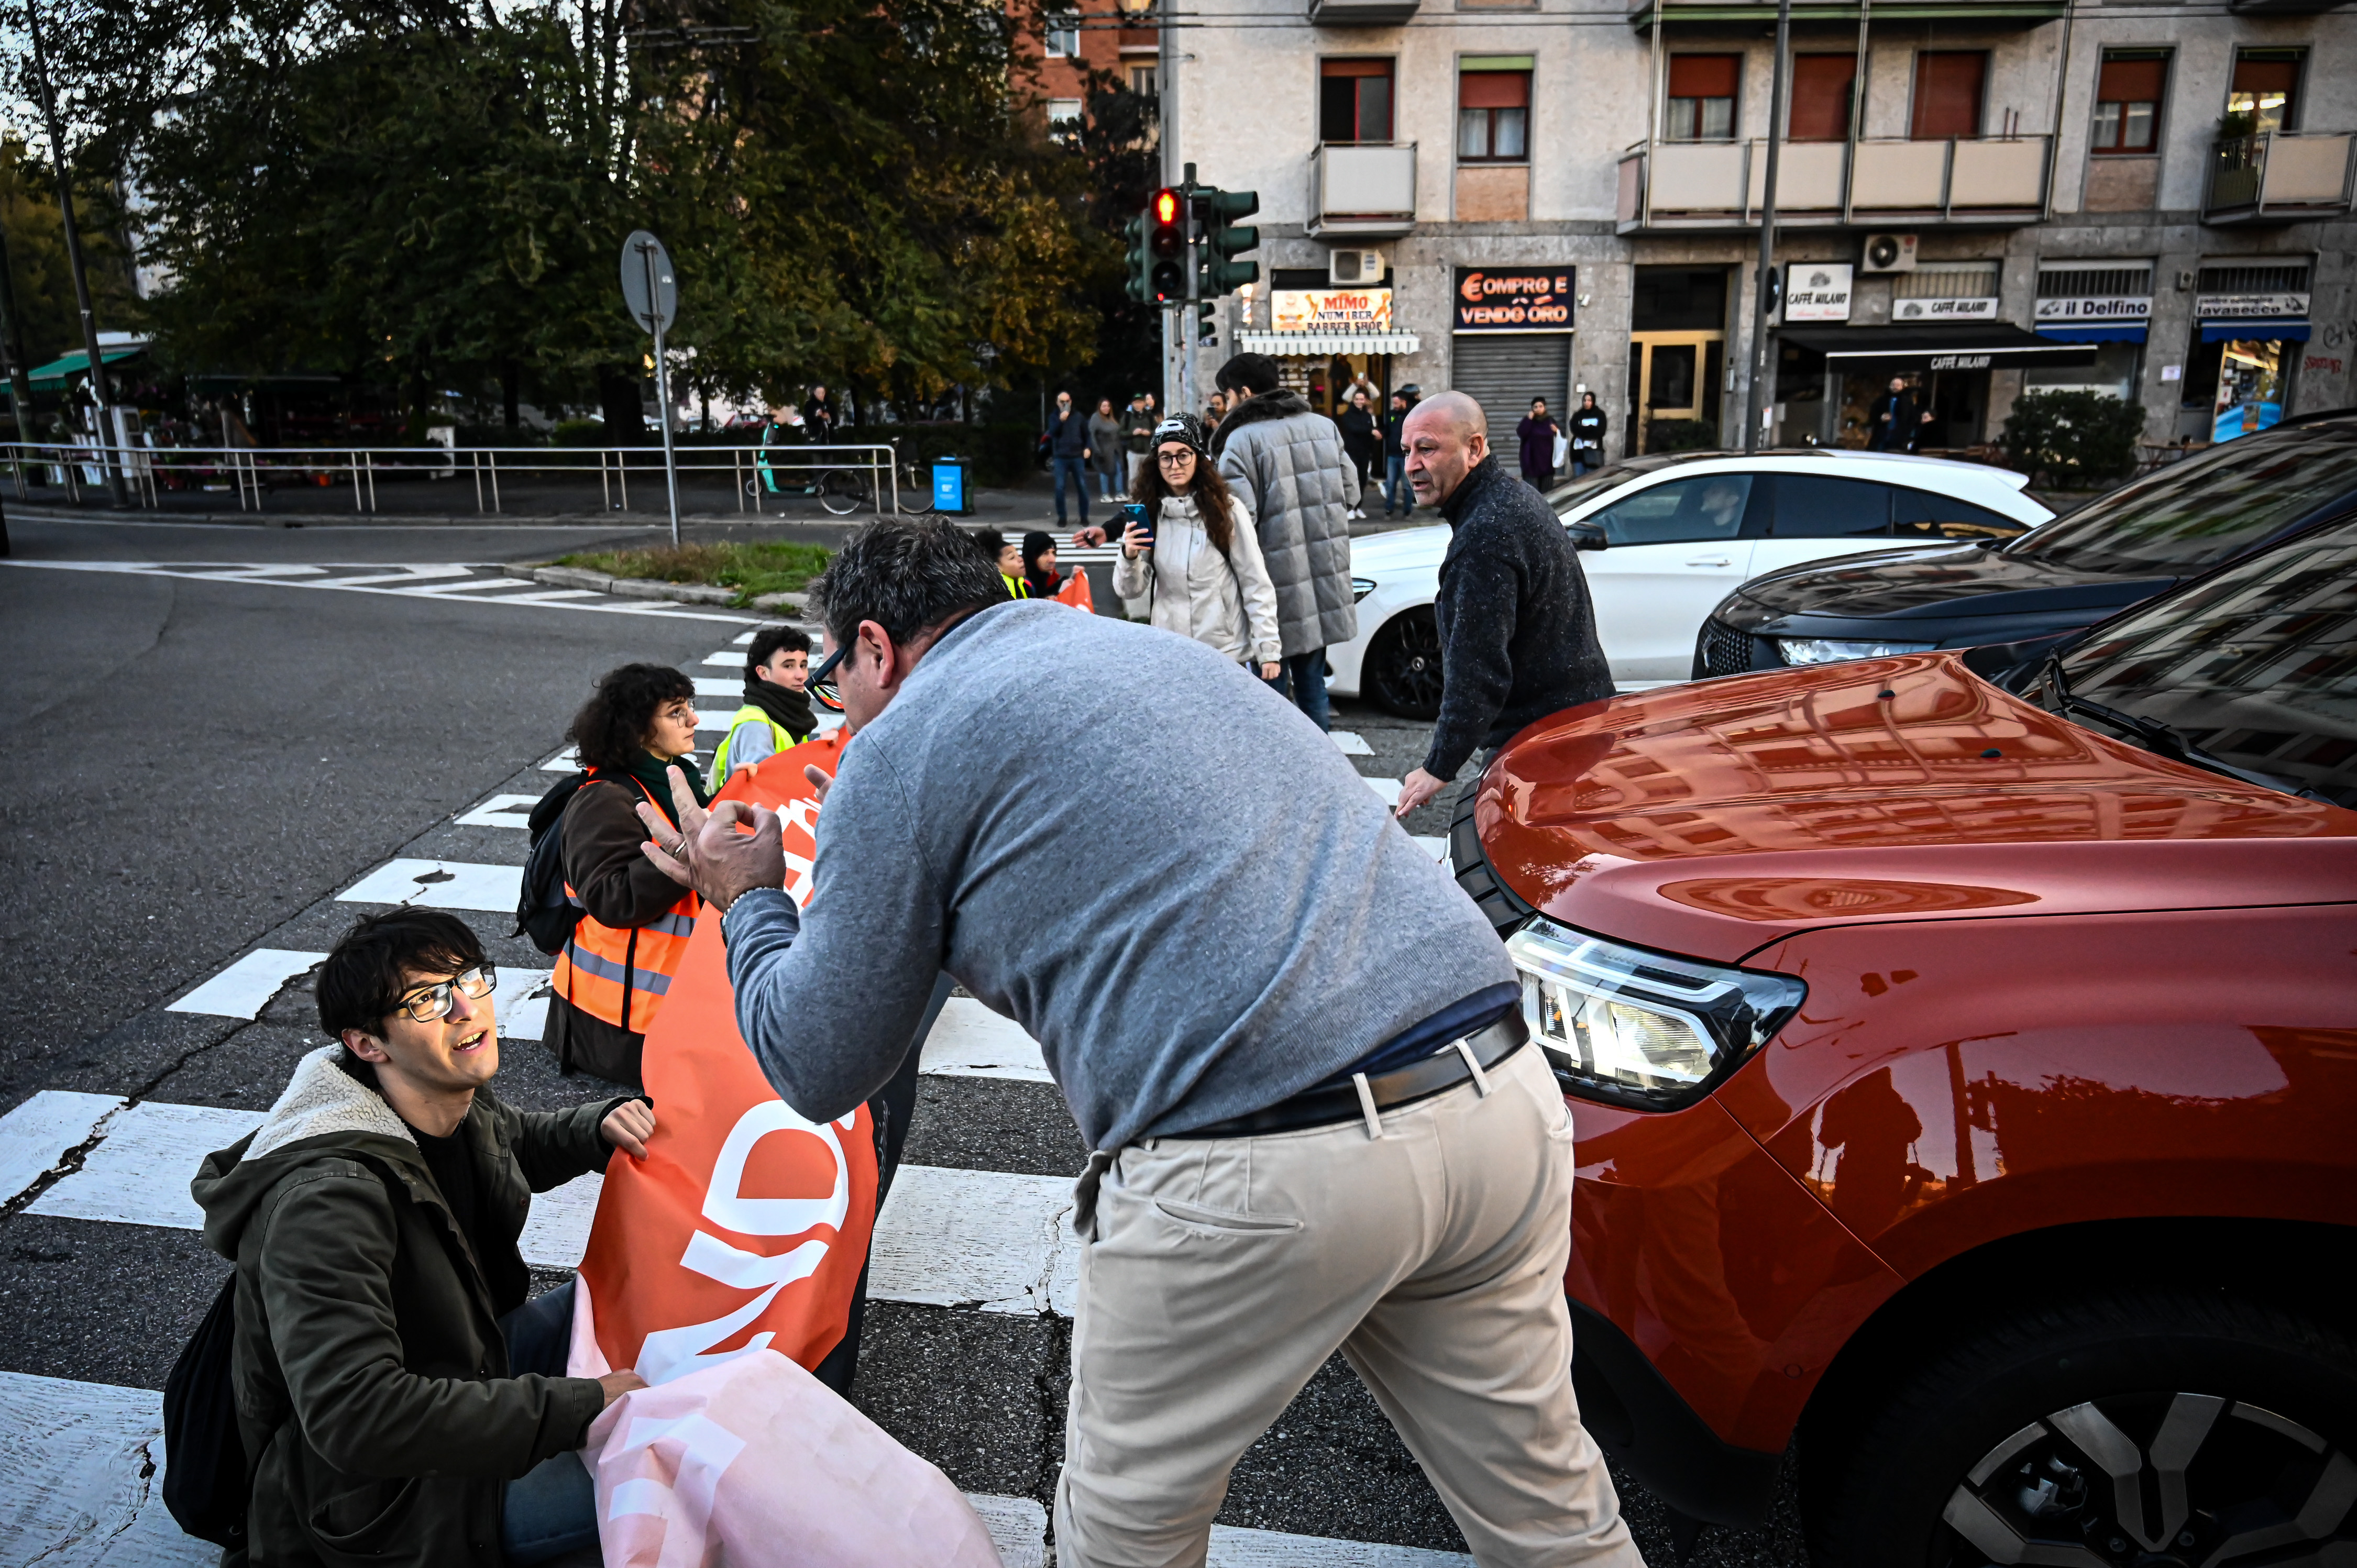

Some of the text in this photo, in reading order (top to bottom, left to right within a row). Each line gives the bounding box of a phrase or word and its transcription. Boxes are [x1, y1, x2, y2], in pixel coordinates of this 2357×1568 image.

[1555, 276, 1568, 294] E
[1324, 296, 1368, 310] MIMO
[2065, 300, 2147, 315] il Delfino
[1460, 305, 1568, 324] VENDO ORO
[1307, 322, 1350, 330] BARBER
[1355, 321, 1382, 330] SHOP
